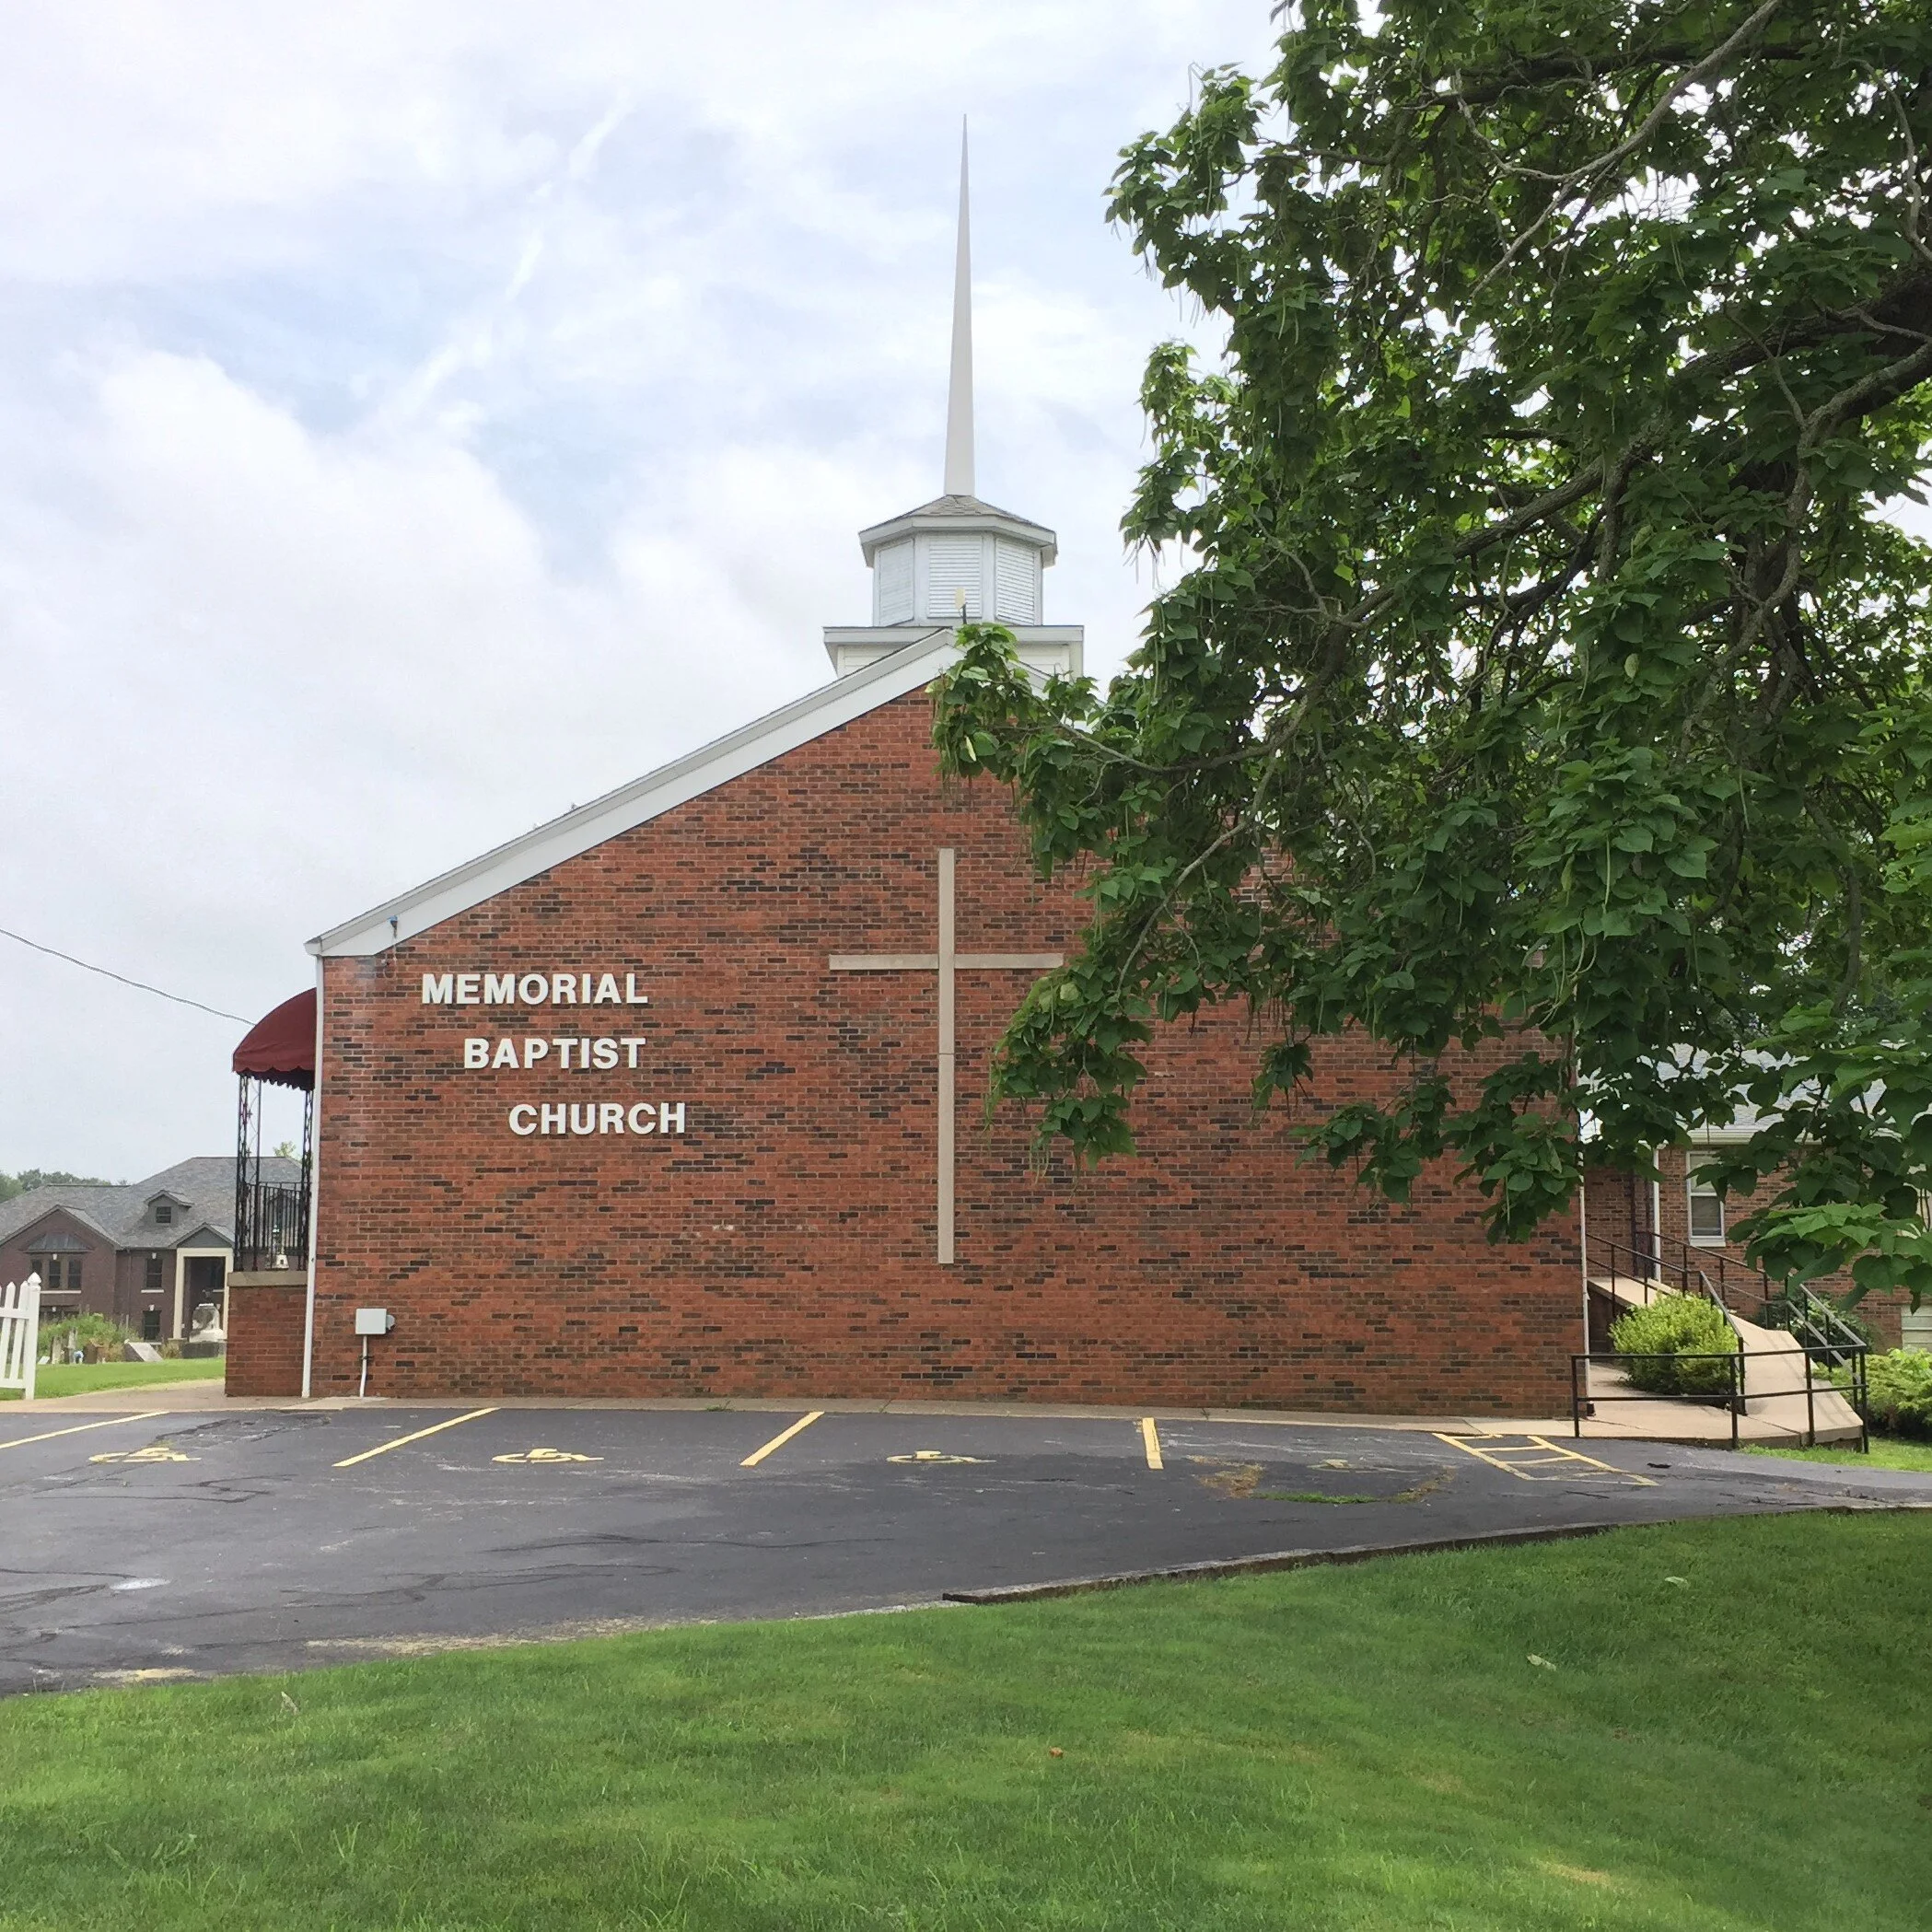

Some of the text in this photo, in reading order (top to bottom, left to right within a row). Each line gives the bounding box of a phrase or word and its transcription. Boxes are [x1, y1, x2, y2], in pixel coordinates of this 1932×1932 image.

[421, 972, 649, 1006] MEMORIAL
[463, 1037, 646, 1070] BAPTIST
[507, 1101, 686, 1136] CHURCH
